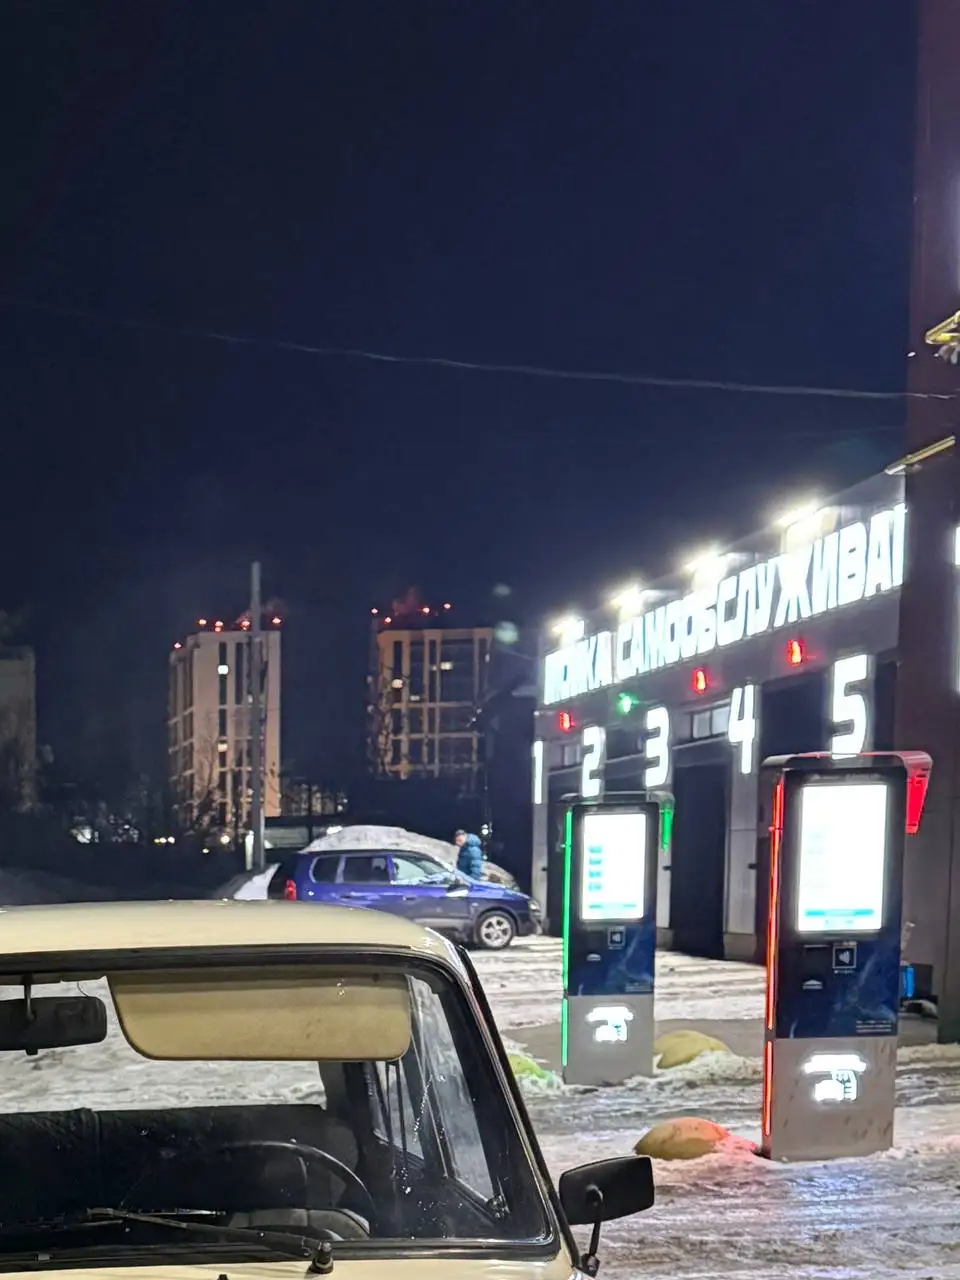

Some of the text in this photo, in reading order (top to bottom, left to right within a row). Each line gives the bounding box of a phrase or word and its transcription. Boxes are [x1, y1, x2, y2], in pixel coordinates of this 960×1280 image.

[645, 706, 670, 787] 3
[728, 684, 756, 774] 4
[831, 654, 869, 760] 5
[532, 740, 544, 804] 1
[581, 725, 606, 798] 2
